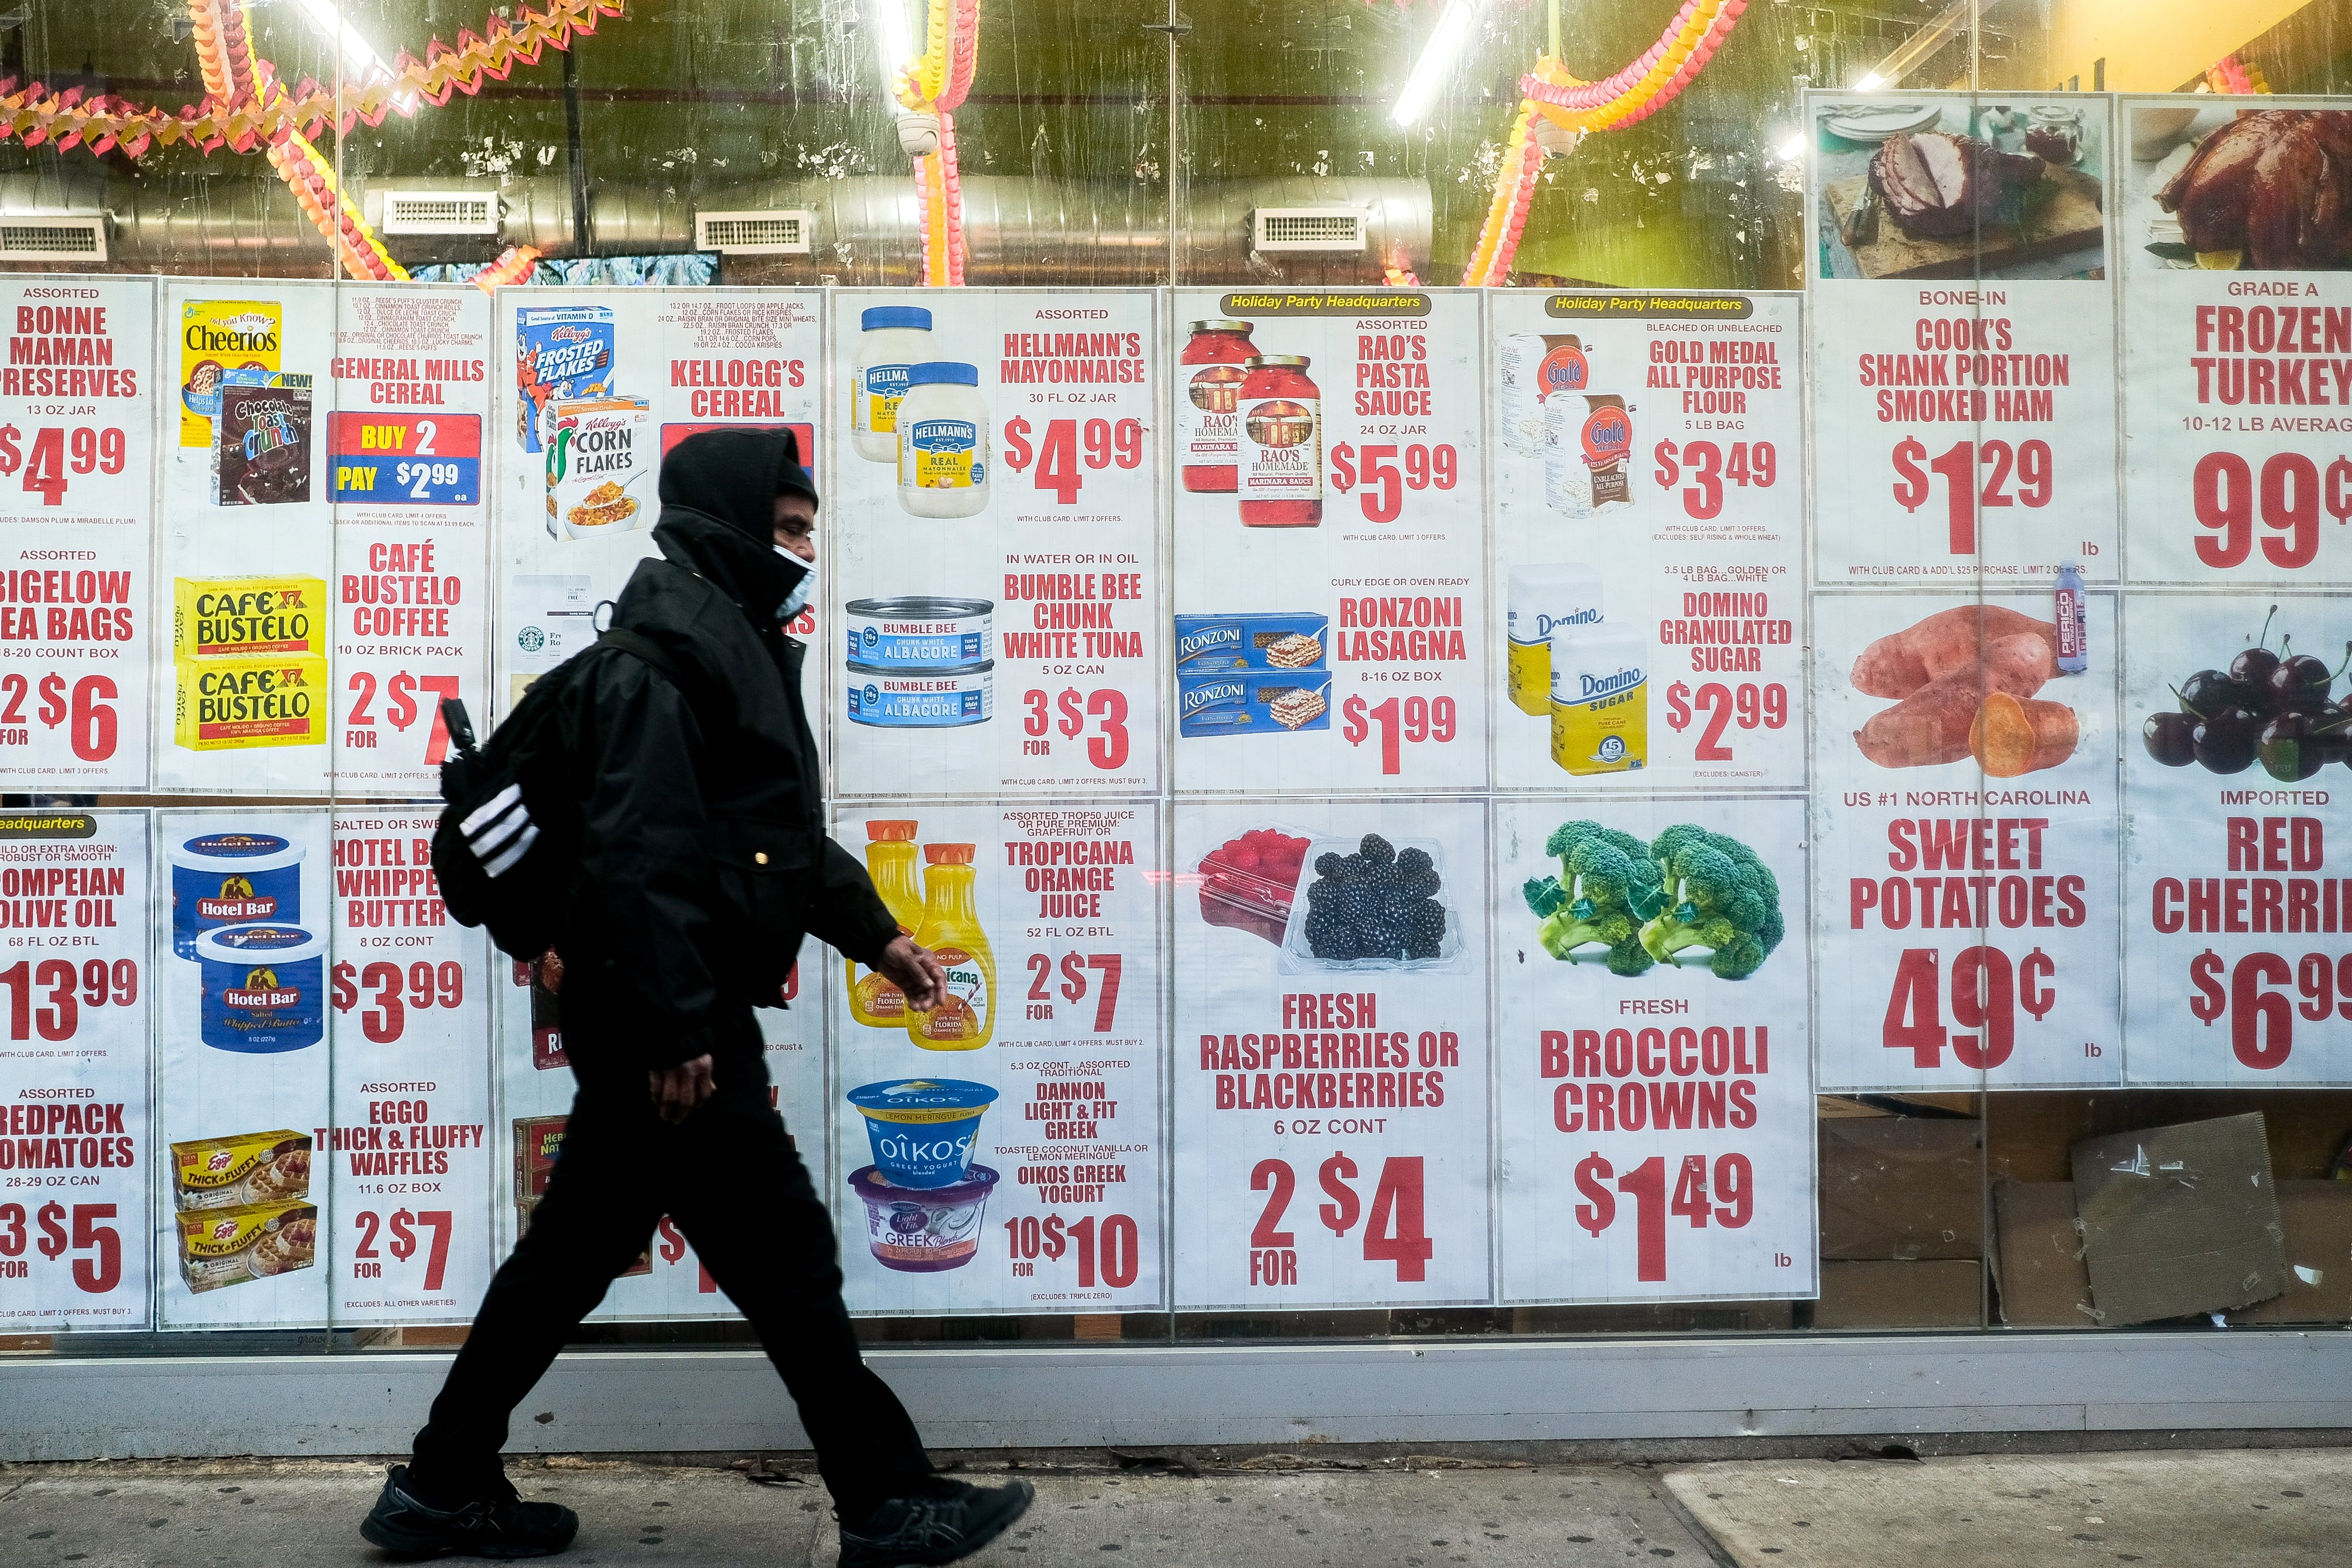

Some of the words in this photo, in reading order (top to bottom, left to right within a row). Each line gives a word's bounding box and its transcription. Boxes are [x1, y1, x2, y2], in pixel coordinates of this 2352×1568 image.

[23, 288, 99, 298] ASSORTED
[1920, 288, 2006, 307] BONE-IN
[2228, 282, 2299, 296] GRADE
[2305, 283, 2319, 296] A
[1036, 310, 1108, 319] ASSORTED
[1231, 295, 1283, 309] Holiday
[1286, 295, 1323, 309] Party
[1327, 295, 1421, 309] Headquarters
[17, 306, 106, 334] BONNE
[186, 324, 278, 353] Cheerios
[1005, 333, 1140, 357] HELLMANN'S
[1916, 316, 2012, 353] COOK'S
[10, 337, 112, 365] MAMAN
[535, 340, 604, 369] FROSTED
[1358, 335, 1426, 360] RAO'S
[1650, 340, 1703, 363] GOLD
[1710, 341, 1778, 364] MEDAL
[281, 373, 313, 388] NEW!
[331, 357, 419, 382] GENERAL
[425, 360, 484, 381] MILLS
[537, 355, 595, 384] FLAKES
[671, 360, 804, 387] KELLOGG'S
[1001, 359, 1145, 384] MAYONNAISE
[1357, 363, 1430, 388] PASTA
[1647, 365, 1681, 388] ALL
[1687, 366, 1781, 390] PURPOSE
[1860, 355, 1947, 387] SHANK
[1956, 355, 2068, 387] PORTION
[371, 382, 445, 405] CEREAL
[691, 390, 784, 417] CEREAL
[1030, 394, 1043, 402] 30
[1049, 394, 1064, 402] FL
[1068, 393, 1086, 402] OZ
[1090, 394, 1116, 402] JAR
[1355, 390, 1431, 416] SAUCE
[1683, 391, 1746, 414] FLOUR
[235, 398, 292, 419] Chocolate
[1877, 391, 1986, 422] SMOKED
[1995, 391, 2053, 422] HAM
[253, 412, 285, 432] Toast
[916, 424, 973, 439] HELLMANN'S
[1590, 421, 1625, 445] Gold
[1685, 420, 1691, 429] 5
[1696, 420, 1712, 429] LB
[1717, 421, 1744, 430] BAG
[2183, 416, 2231, 431] 10-12
[2239, 418, 2264, 431] LB
[243, 423, 299, 461] Crunch
[361, 424, 406, 450] BUY
[415, 421, 437, 455] 2
[576, 428, 632, 453] CORN
[576, 452, 633, 474] FLAKES
[931, 456, 958, 466] REAL
[1251, 462, 1308, 471] HOMEMADE
[337, 466, 377, 491] PAY
[20, 551, 96, 560] ASSORTED
[370, 539, 434, 572] CAFÉ
[1007, 555, 1019, 563] IN
[1024, 555, 1070, 563] WATER
[1075, 554, 1094, 563] OR
[1100, 554, 1112, 563] IN
[1117, 554, 1139, 563] OIL
[2083, 542, 2098, 555] lb
[343, 575, 460, 605] BUSTELO
[1005, 574, 1095, 600] BUMBLE
[1102, 573, 1141, 599] BEE
[1034, 603, 1113, 630] CHUNK
[1340, 597, 1462, 628] RONZONI
[1684, 592, 1767, 617] DOMINO
[47, 607, 132, 641] BAGS
[354, 607, 448, 637] COFFEE
[883, 623, 933, 634] BUMBLE
[936, 623, 957, 633] BEE
[1660, 620, 1791, 644] GRANULATED
[2060, 592, 2071, 654] PERICO
[338, 645, 351, 654] 10
[357, 645, 374, 654] OZ
[380, 646, 422, 655] BRICK
[427, 647, 463, 656] PACK
[884, 646, 958, 659] ALBACORE
[1003, 632, 1077, 658] WHITE
[1083, 632, 1143, 658] TUNA
[1338, 630, 1466, 661] LASAGNA
[1043, 665, 1049, 674] 5
[1054, 665, 1071, 674] OZ
[1076, 665, 1104, 674] CAN
[1691, 647, 1761, 672] SUGAR
[197, 668, 278, 695] CAFÉ
[1579, 668, 1641, 697] Domino
[199, 695, 309, 723] BUSTELO
[1184, 683, 1244, 711] RONZONI
[1589, 691, 1634, 712] SUGAR
[1844, 792, 1872, 807] US
[1877, 792, 1897, 807] #1
[1906, 791, 1978, 806] NORTH
[1985, 791, 2090, 805] CAROLINA
[2221, 791, 2329, 805] IMPORTED
[1005, 841, 1134, 866] TROPICANA
[1888, 817, 2049, 873] SWEET
[2227, 817, 2323, 872] RED
[1026, 867, 1114, 893] ORANGE
[75, 899, 117, 927] OIL
[349, 899, 448, 927] BUTTER
[1039, 894, 1100, 918] JUICE
[1851, 873, 2086, 932] POTATOES
[360, 938, 367, 947] 8
[372, 937, 390, 947] OZ
[395, 937, 433, 947] CONT
[228, 991, 266, 1005] Hotel
[270, 991, 297, 1005] Bar
[1620, 999, 1688, 1014] FRESH
[1283, 993, 1375, 1029] FRESH
[1200, 1032, 1409, 1070] RASPBERRIES
[1418, 1031, 1458, 1068] OR
[1541, 1026, 1768, 1078] BROCCOLI
[2085, 1043, 2101, 1057] lb
[1037, 1082, 1105, 1100] DANNON
[1216, 1071, 1444, 1109] BLACKBERRIES
[370, 1100, 428, 1124] EGGO
[886, 1112, 912, 1121] LEMON
[915, 1112, 956, 1121] MERINGUE
[1025, 1102, 1073, 1121] LIGHT
[1077, 1104, 1088, 1119] &
[1093, 1101, 1117, 1119] FIT
[1554, 1080, 1757, 1132] CROWNS
[1046, 1121, 1098, 1140] GREEK
[350, 1150, 448, 1176] WAFFLES
[359, 1184, 384, 1194] 11.6
[388, 1184, 407, 1193] OZ
[412, 1183, 441, 1193] BOX
[886, 1233, 933, 1247] GREEK
[1775, 1253, 1791, 1267] lb
